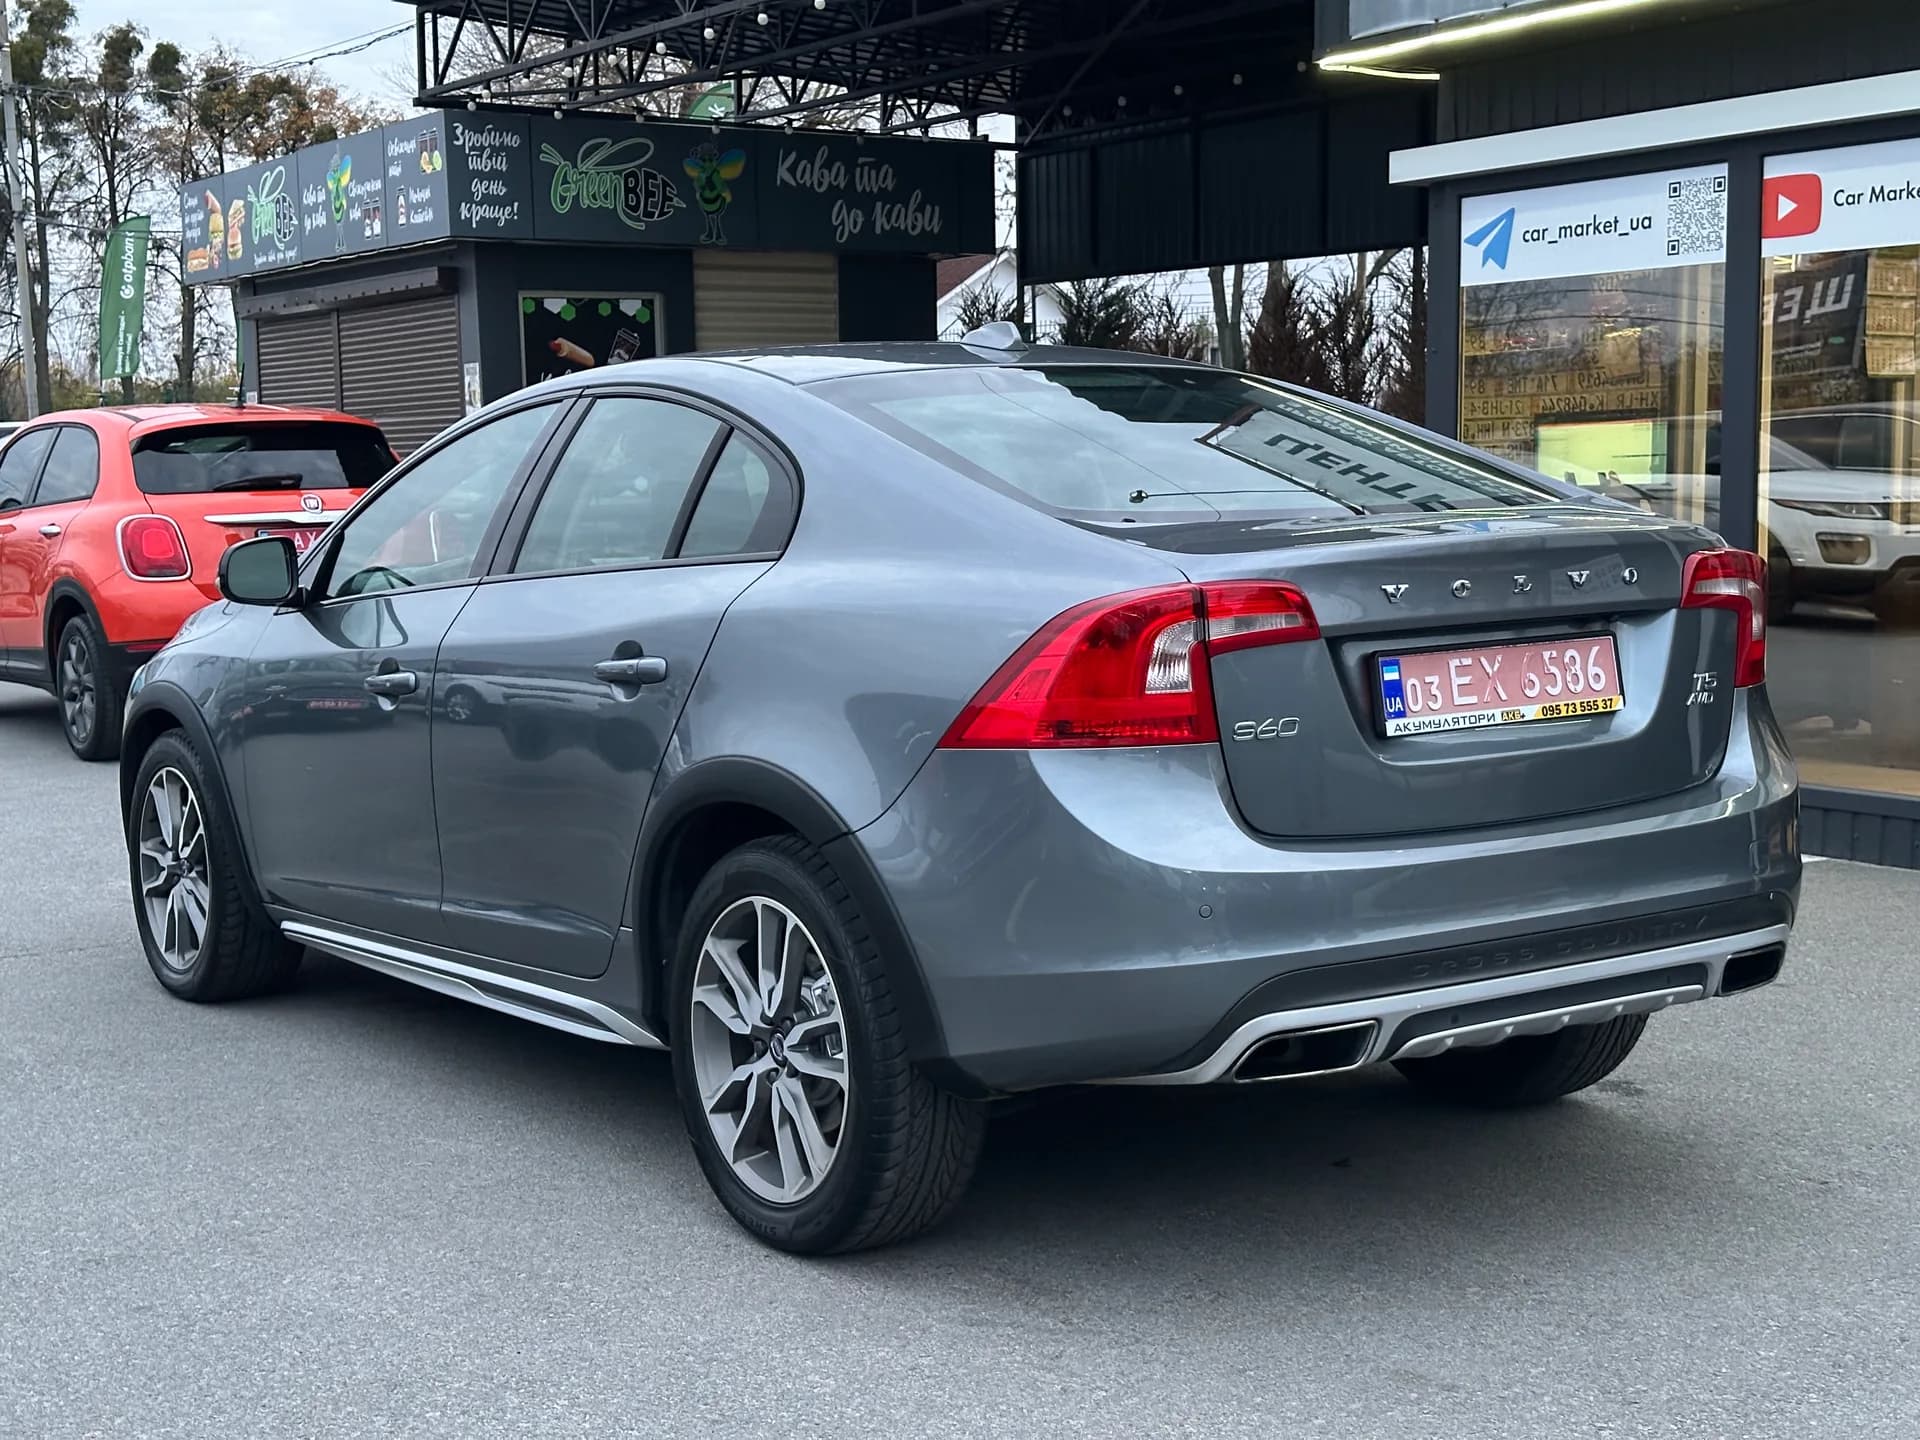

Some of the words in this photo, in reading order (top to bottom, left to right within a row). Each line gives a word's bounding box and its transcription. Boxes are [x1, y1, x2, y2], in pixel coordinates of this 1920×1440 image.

[452, 122, 521, 153] Зробимо
[468, 151, 508, 172] твій
[777, 145, 848, 193] Кава
[855, 157, 896, 193] та
[471, 177, 508, 201] день
[1834, 190, 1864, 206] Car
[459, 201, 519, 228] краще!
[832, 200, 864, 243] до
[873, 189, 943, 236] кави
[1522, 214, 1652, 245] car_market_ua
[1381, 567, 1639, 603] VOLVO
[1406, 675, 1442, 713] 03
[1449, 655, 1508, 706] EX
[1520, 645, 1606, 698] 6586
[1693, 671, 1718, 691] T5
[1386, 697, 1403, 713] UA
[1541, 703, 1562, 718] 095
[1564, 701, 1578, 715] 73
[1580, 699, 1599, 714] 555
[1601, 697, 1614, 711] 37
[1233, 717, 1300, 741] S60
[1393, 713, 1496, 735] АКУМУЛЯТОРИ
